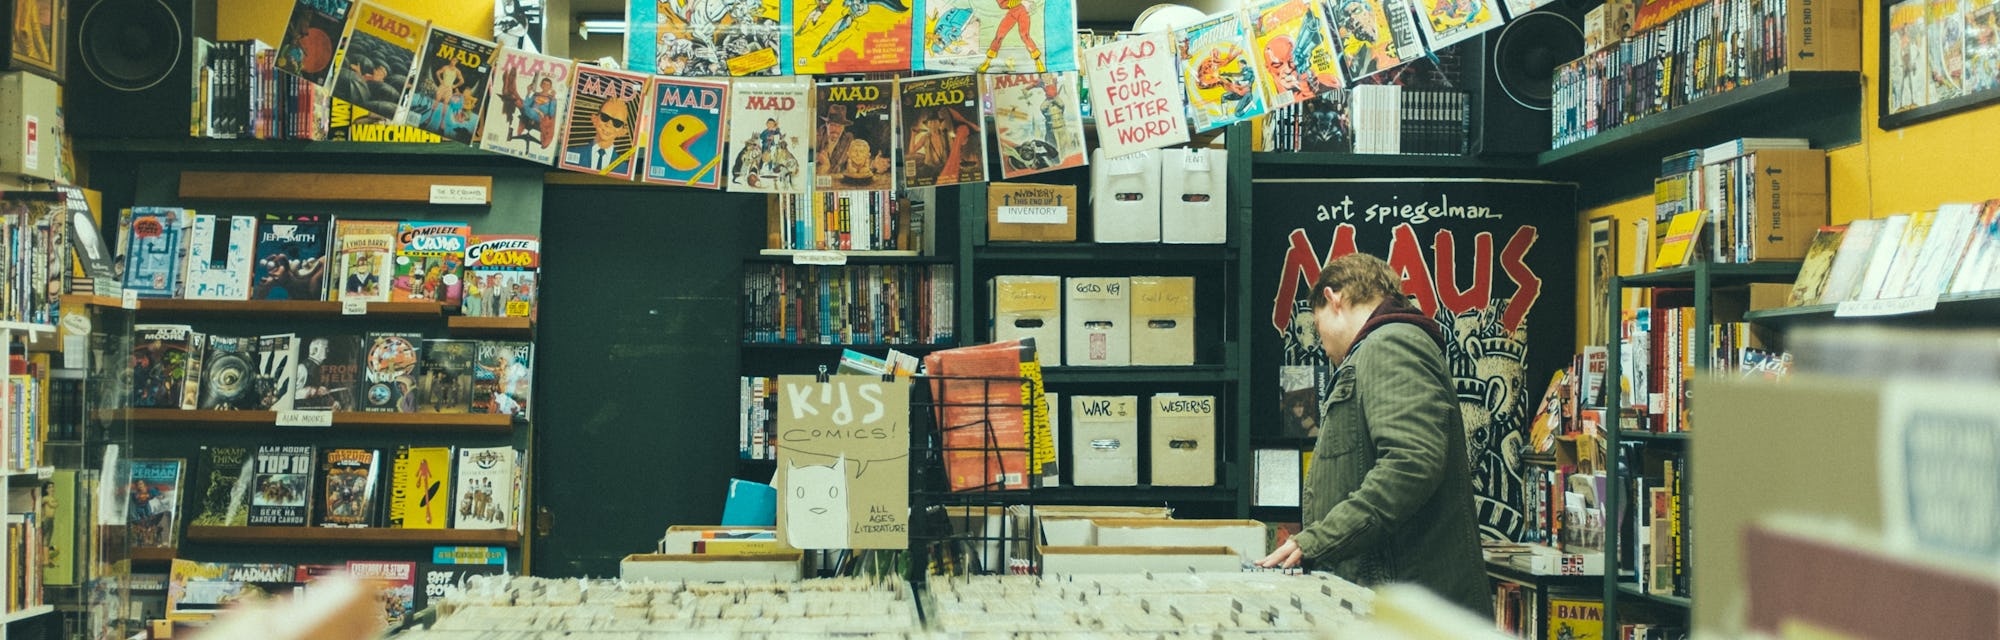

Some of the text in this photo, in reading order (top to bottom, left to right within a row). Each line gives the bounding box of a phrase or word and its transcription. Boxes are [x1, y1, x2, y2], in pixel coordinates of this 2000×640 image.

[366, 12, 411, 38] MAD
[1803, 8, 1812, 25] END
[1803, 26, 1812, 45] THIS
[436, 44, 481, 69] MAD
[502, 53, 568, 82] MAD
[1110, 64, 1146, 83] IS A
[581, 76, 637, 101] MAD
[828, 86, 880, 102] MAD
[1106, 80, 1162, 105] FOUR-
[660, 87, 718, 110] MAD
[745, 96, 795, 111] MAD
[914, 89, 965, 108] MAD
[1104, 98, 1169, 127] LETTER
[1117, 116, 1178, 145] WORD!
[1008, 207, 1057, 215] INVENTORY
[1316, 193, 1504, 225] art spiegelman
[1772, 179, 1781, 229] THIS END UP
[261, 231, 315, 243] JEFF SMITH
[345, 238, 388, 249] LYNDA BARRY
[401, 226, 458, 244] COMPLETE
[412, 234, 461, 251] CRUMB
[468, 240, 530, 259] COMPLETE
[480, 248, 532, 267] CRUMB
[1271, 222, 1542, 337] MAUS
[1075, 281, 1121, 296] GOLD KEY
[320, 365, 358, 374] FROM
[320, 374, 356, 382] HELL
[1082, 400, 1113, 417] WAR
[1159, 399, 1211, 414] WESTERNS
[282, 414, 325, 424] ALAN MOORE
[783, 422, 898, 441] COMICS!
[211, 447, 246, 457] SWAMP
[258, 445, 311, 454] ALAN MOORE
[212, 455, 242, 464] THING
[258, 456, 308, 474] TOP 10
[131, 467, 177, 478] PERMAN
[390, 458, 408, 520] WATCHMEN
[260, 508, 296, 517] GENE HA
[870, 504, 888, 514] ALL
[869, 514, 895, 523] AGES
[854, 523, 906, 534] LITERATURE
[232, 567, 284, 582] MADMAN
[427, 570, 454, 584] BAT
[1557, 604, 1601, 621] BATM
